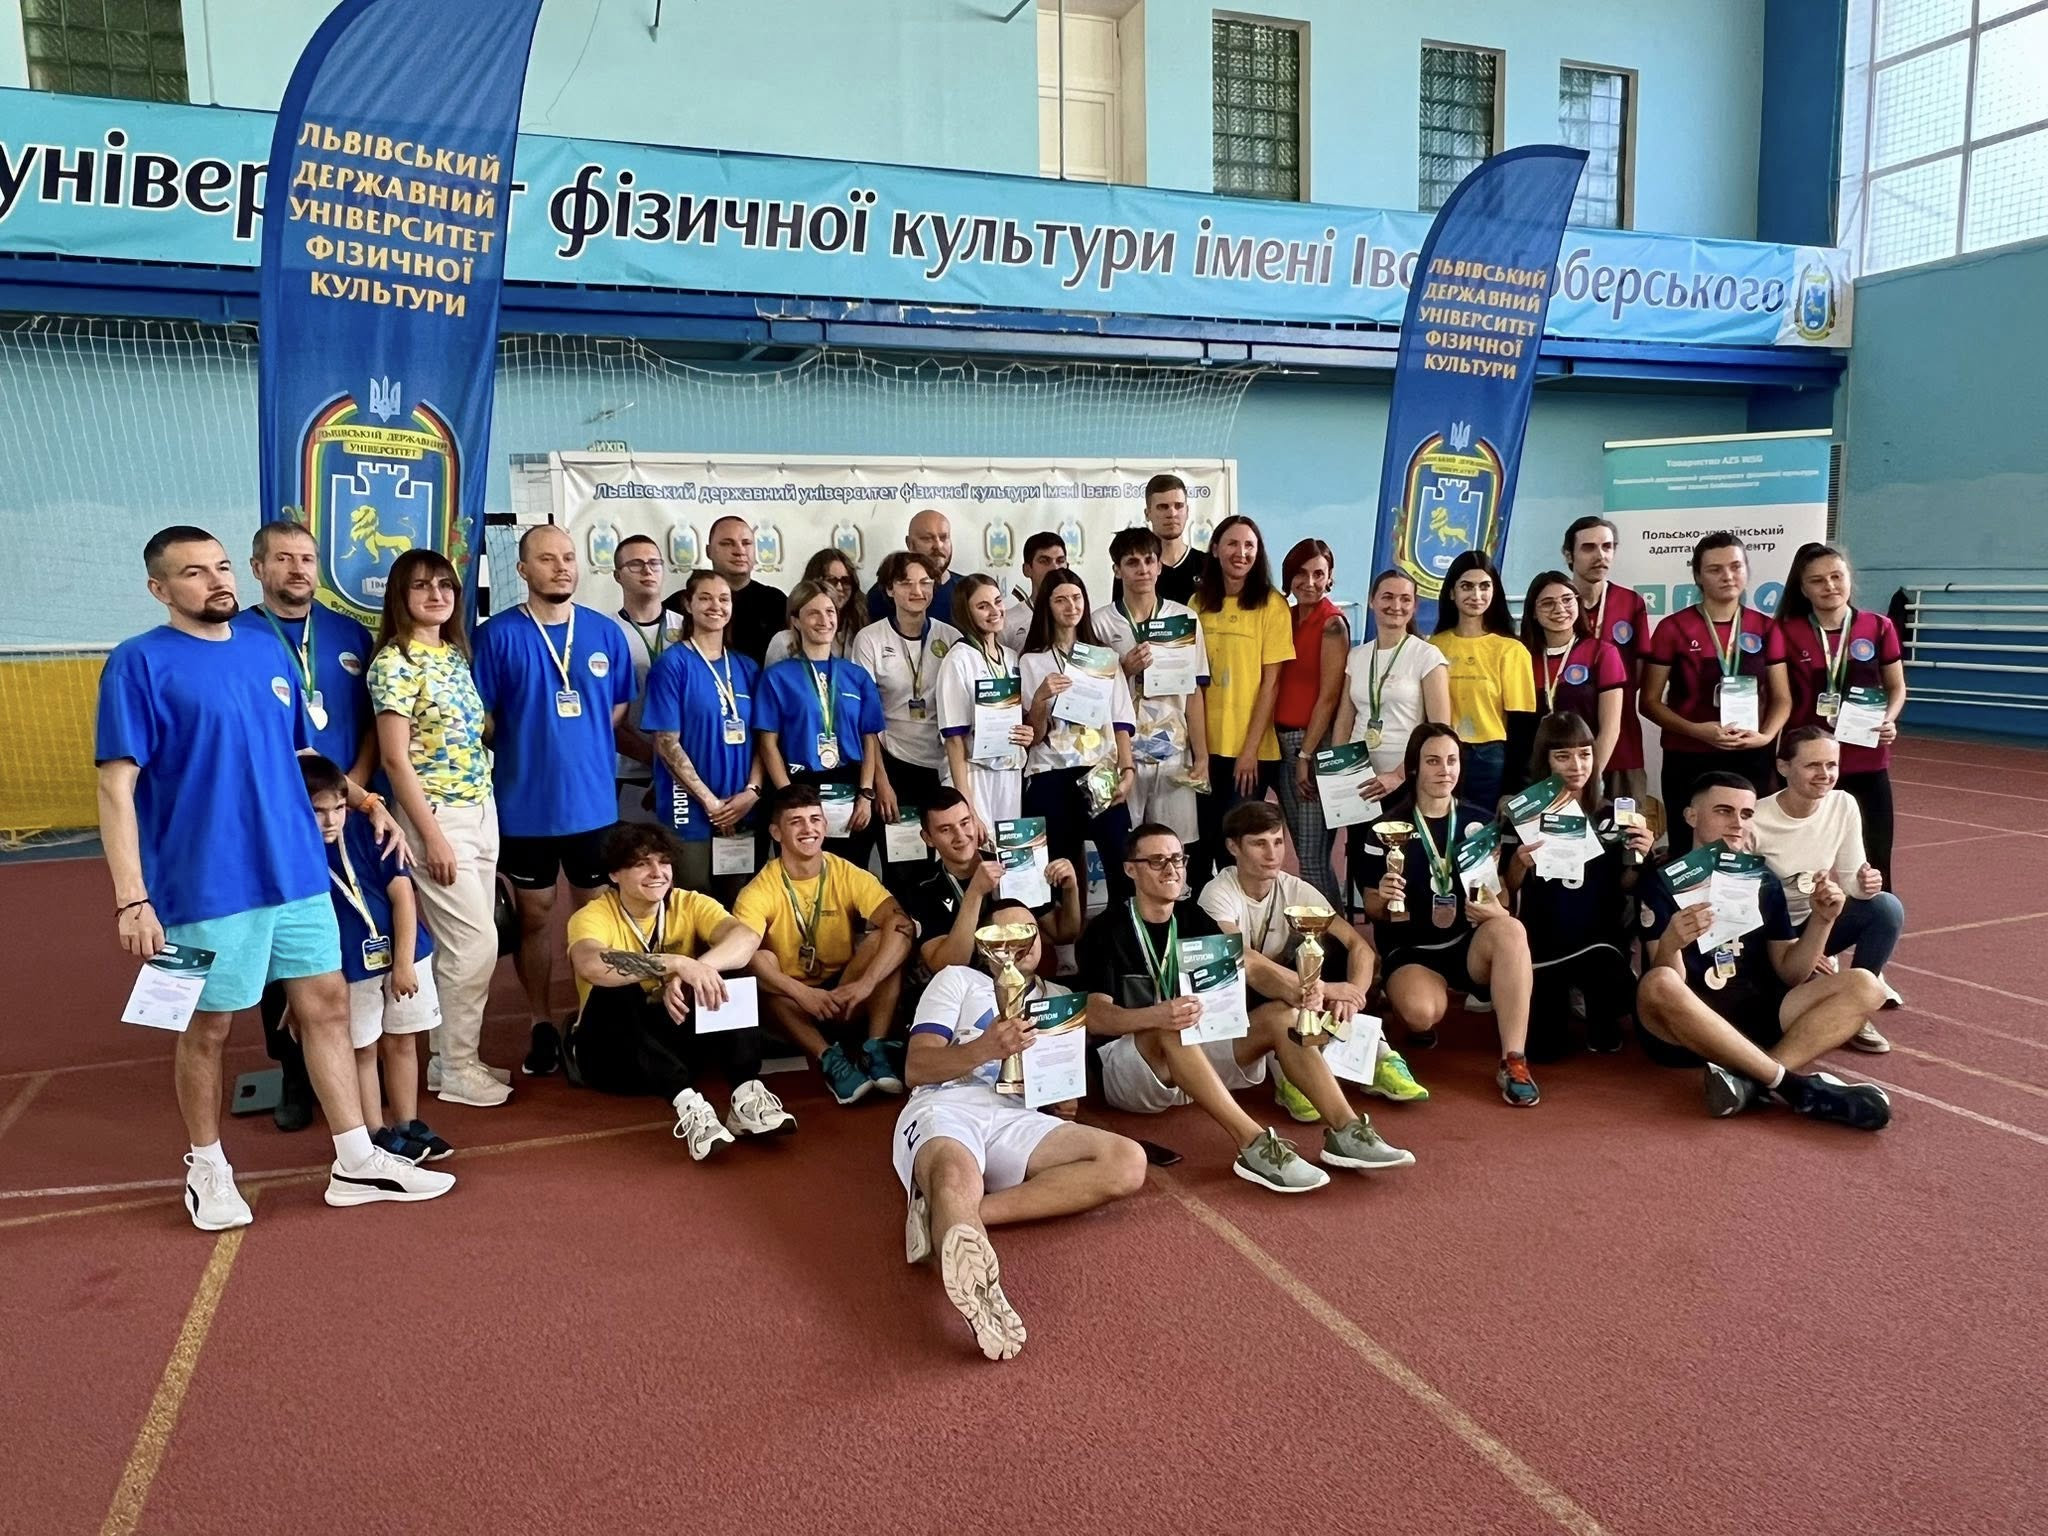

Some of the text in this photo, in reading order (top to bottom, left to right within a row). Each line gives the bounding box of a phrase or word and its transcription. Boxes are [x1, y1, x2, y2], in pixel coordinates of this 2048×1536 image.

[298, 122, 501, 184] ЛЬВІВСЬКИЙ
[293, 160, 495, 219] ДЕРЖАВНИЙ
[289, 196, 495, 253] УНІВЕРСИТЕТ
[549, 163, 879, 259] фізичної
[891, 210, 1175, 290] культури
[1194, 217, 1336, 285] імені
[1550, 248, 1785, 320] берського
[305, 235, 475, 284] ФІЗИЧНОЇ
[1428, 258, 1547, 289] ЛЬВІВСЬКИЙ
[310, 271, 466, 317] КУЛЬТУРИ
[1422, 282, 1541, 314] ДЕРЖАВНИЙ
[1418, 306, 1537, 337] УНІВЕРСИТЕТ
[1425, 330, 1524, 358] ФІЗИЧНОЇ
[1424, 353, 1517, 380] КУЛЬТУРИ
[588, 440, 627, 452] ИХІД
[593, 481, 696, 500] Львівський
[699, 484, 796, 504] державний
[799, 484, 898, 504] університет
[901, 482, 969, 502] фізичної
[970, 485, 1040, 503] культури
[1082, 484, 1121, 498] Івана
[1745, 542, 1776, 552] ентр
